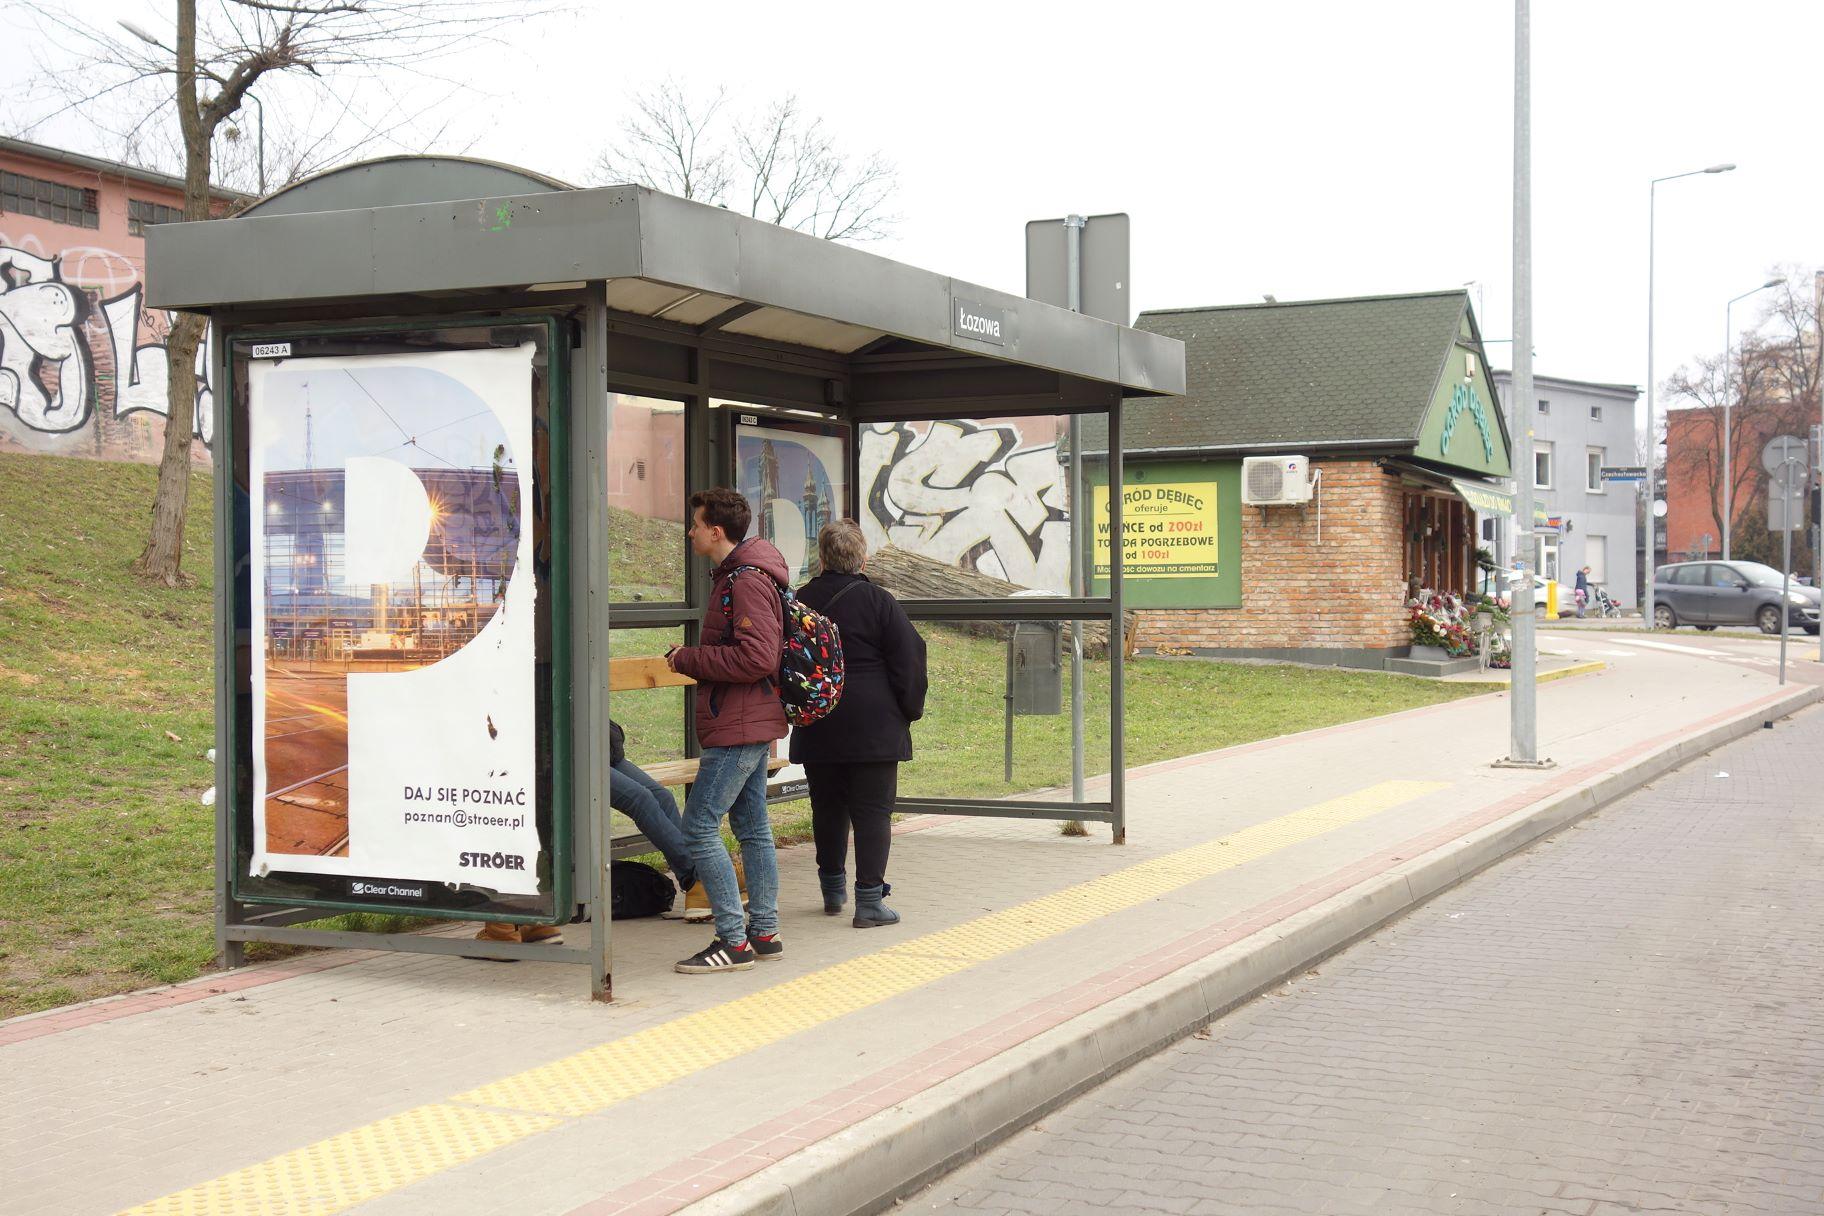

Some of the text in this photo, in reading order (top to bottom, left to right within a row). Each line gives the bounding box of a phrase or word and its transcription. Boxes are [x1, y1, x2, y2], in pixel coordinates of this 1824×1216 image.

[960, 307, 1001, 337] Łozowa
[255, 345, 288, 355] 06243 A
[1105, 488, 1203, 513] ORÓD DĘBIEC
[1134, 503, 1168, 513] oferuje
[1149, 522, 1163, 533] od
[1098, 536, 1214, 548] TODA POGRZEBOWE
[1125, 551, 1137, 560] od
[404, 786, 526, 807] DAJ SIĘ POZNAĆ
[404, 809, 525, 830] poznan@stroeer.pl
[459, 851, 526, 871] STRÖER
[364, 884, 423, 897] Clear Channel
